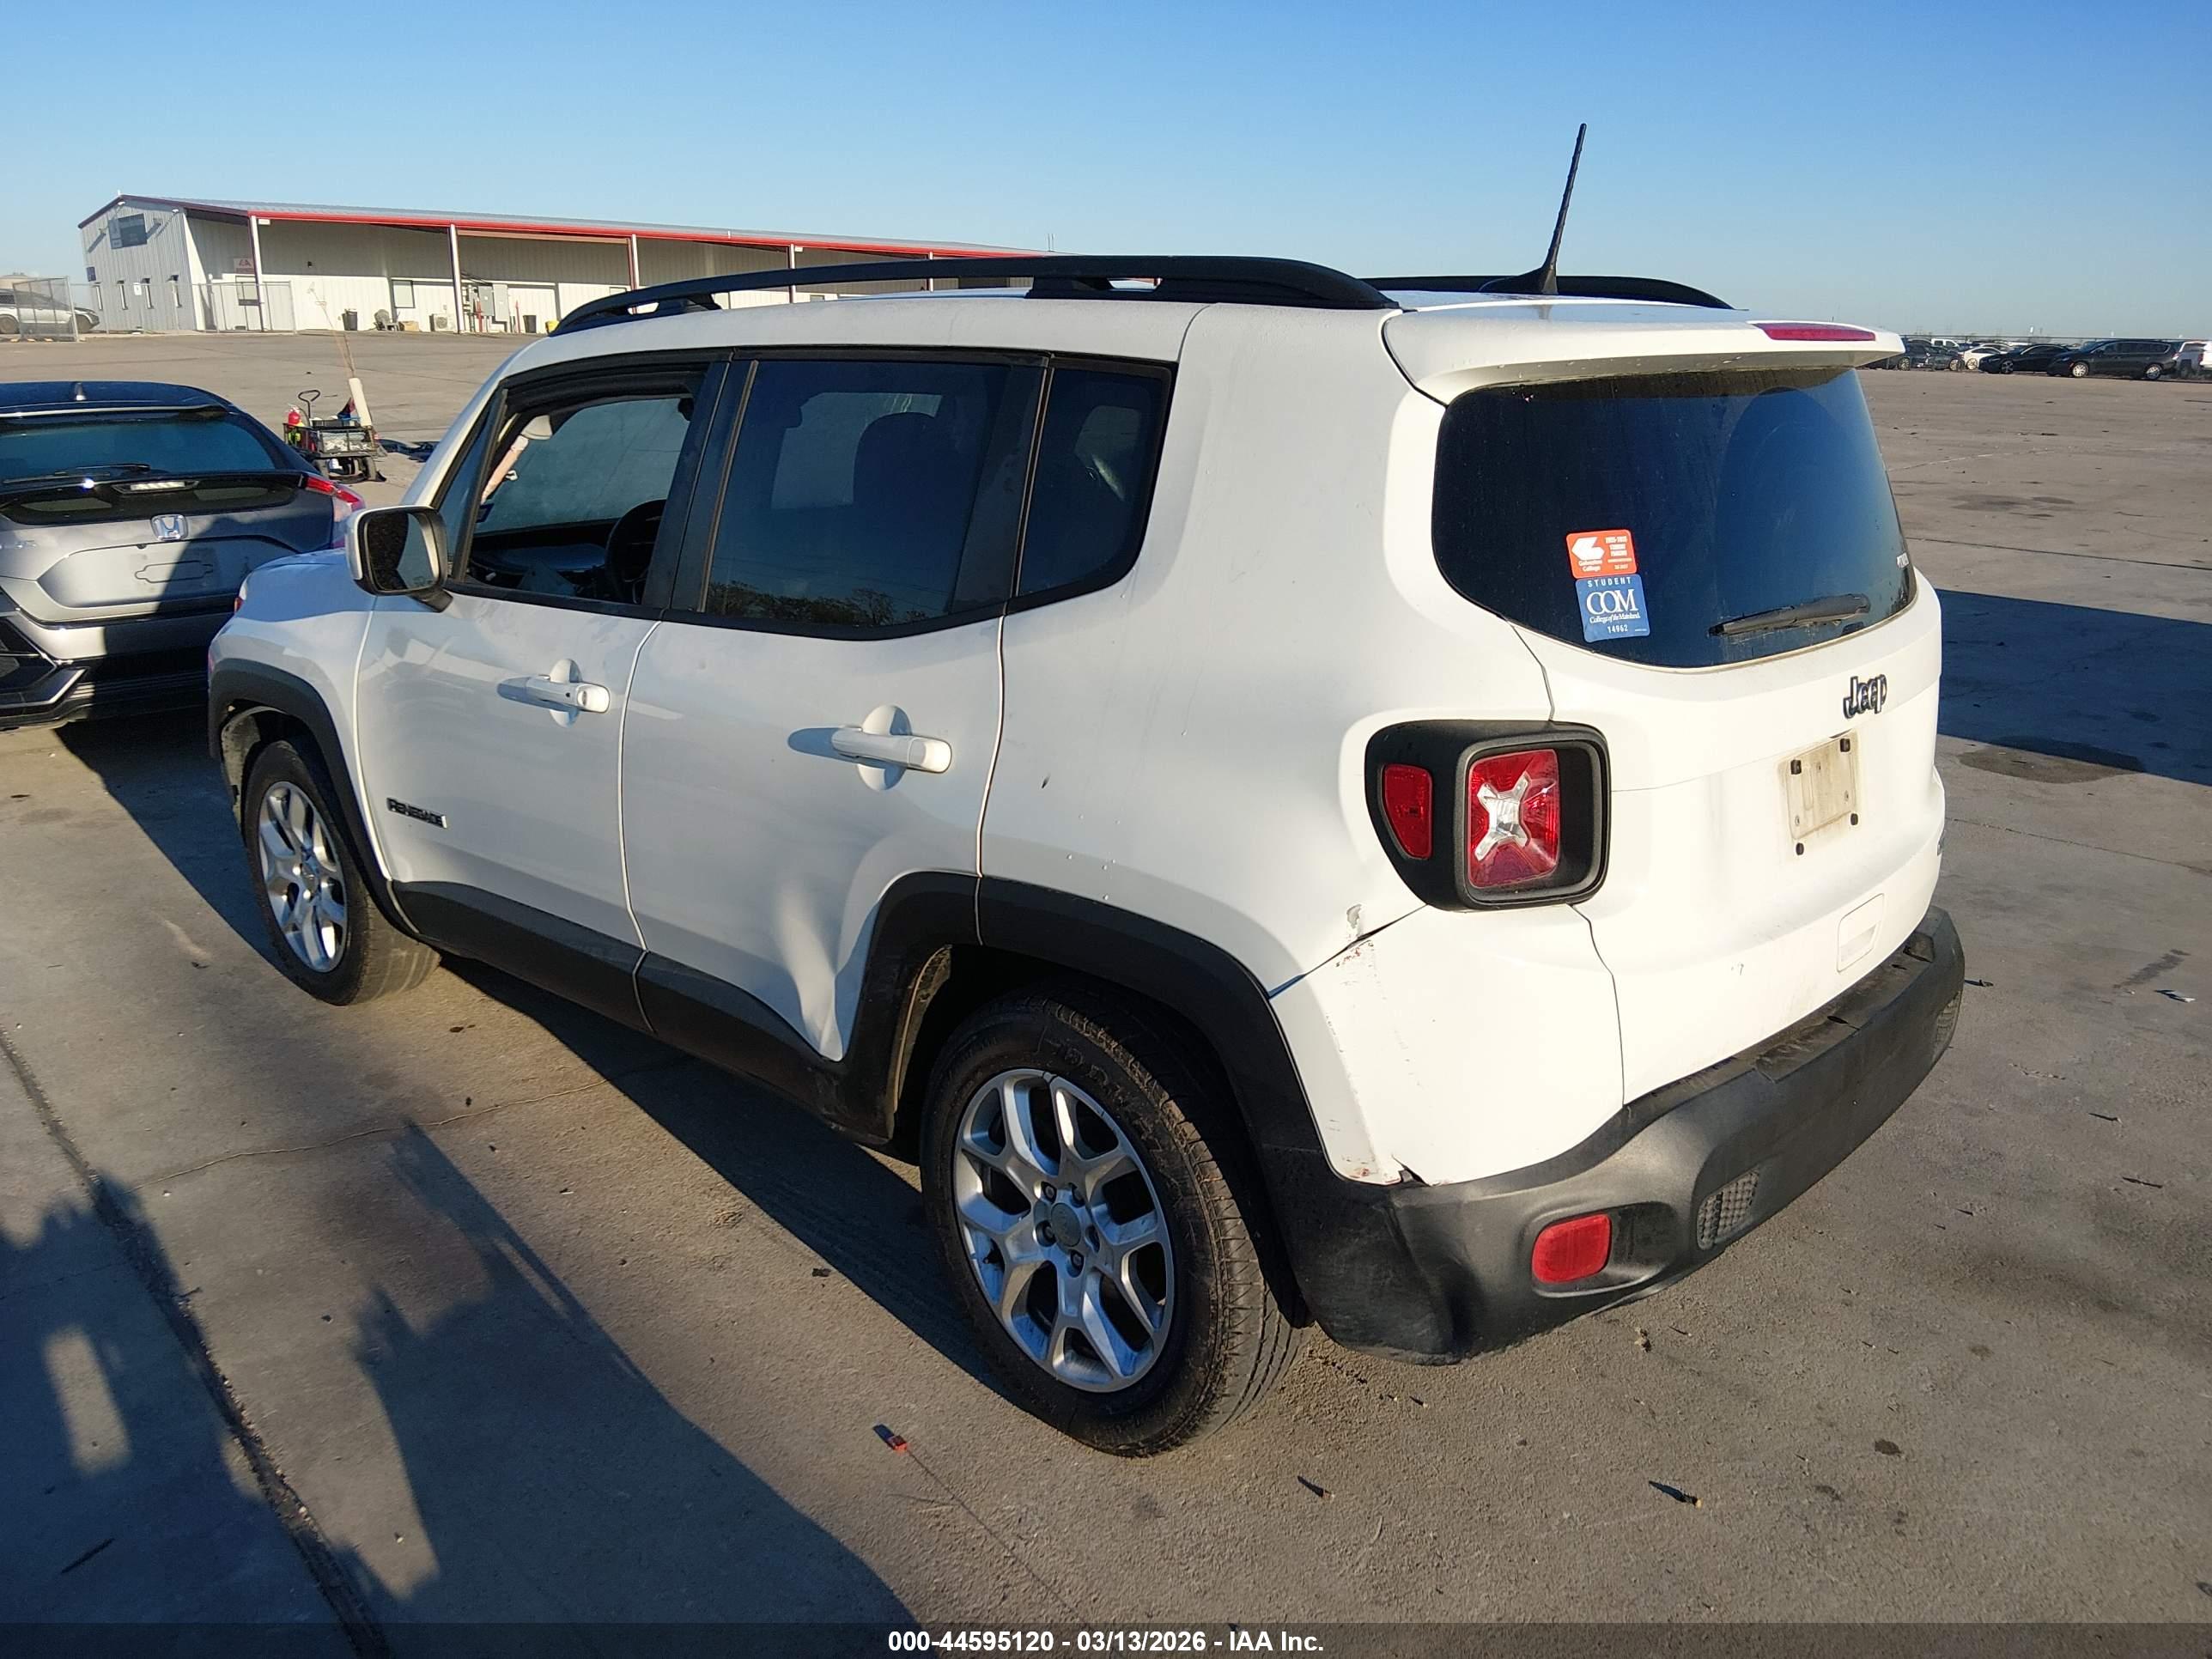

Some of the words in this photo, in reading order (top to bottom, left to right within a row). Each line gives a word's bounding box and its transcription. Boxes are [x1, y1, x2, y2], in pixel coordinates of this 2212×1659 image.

[1588, 576, 1631, 587] STUDENT
[1586, 588, 1639, 615] COM
[1843, 673, 1887, 720] Jeep
